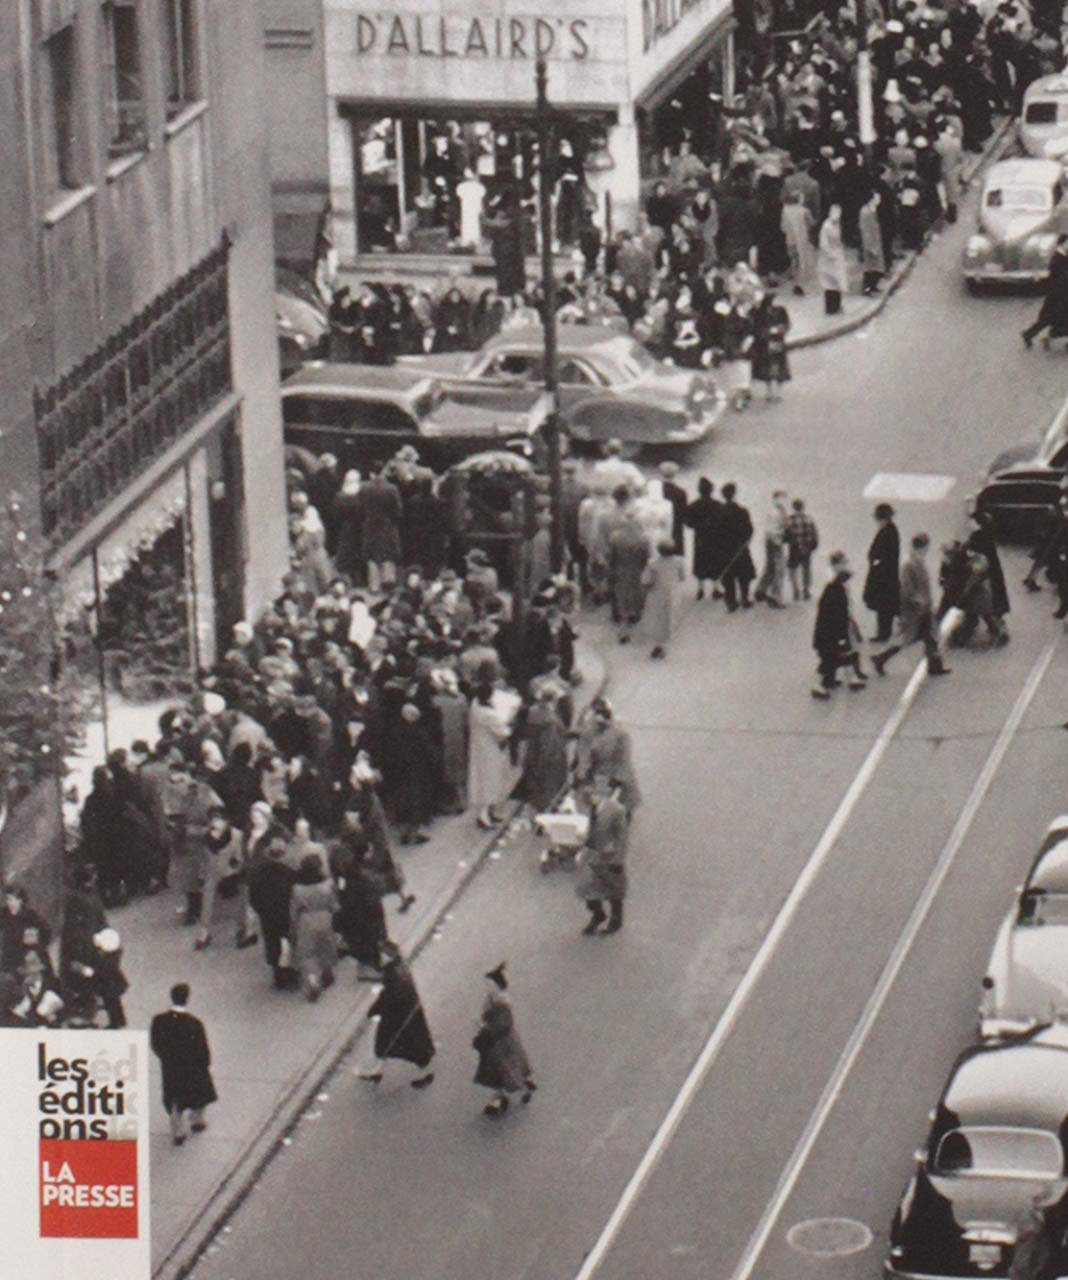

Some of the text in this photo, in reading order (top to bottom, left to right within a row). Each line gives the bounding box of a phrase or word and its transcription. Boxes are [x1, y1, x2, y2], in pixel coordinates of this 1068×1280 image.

[355, 14, 591, 61] D'ALLAIRD'S
[38, 1042, 89, 1082] les
[39, 1080, 125, 1115] éditi
[39, 1117, 109, 1141] ons
[42, 1160, 76, 1184] LA
[42, 1184, 135, 1208] PRESSE
